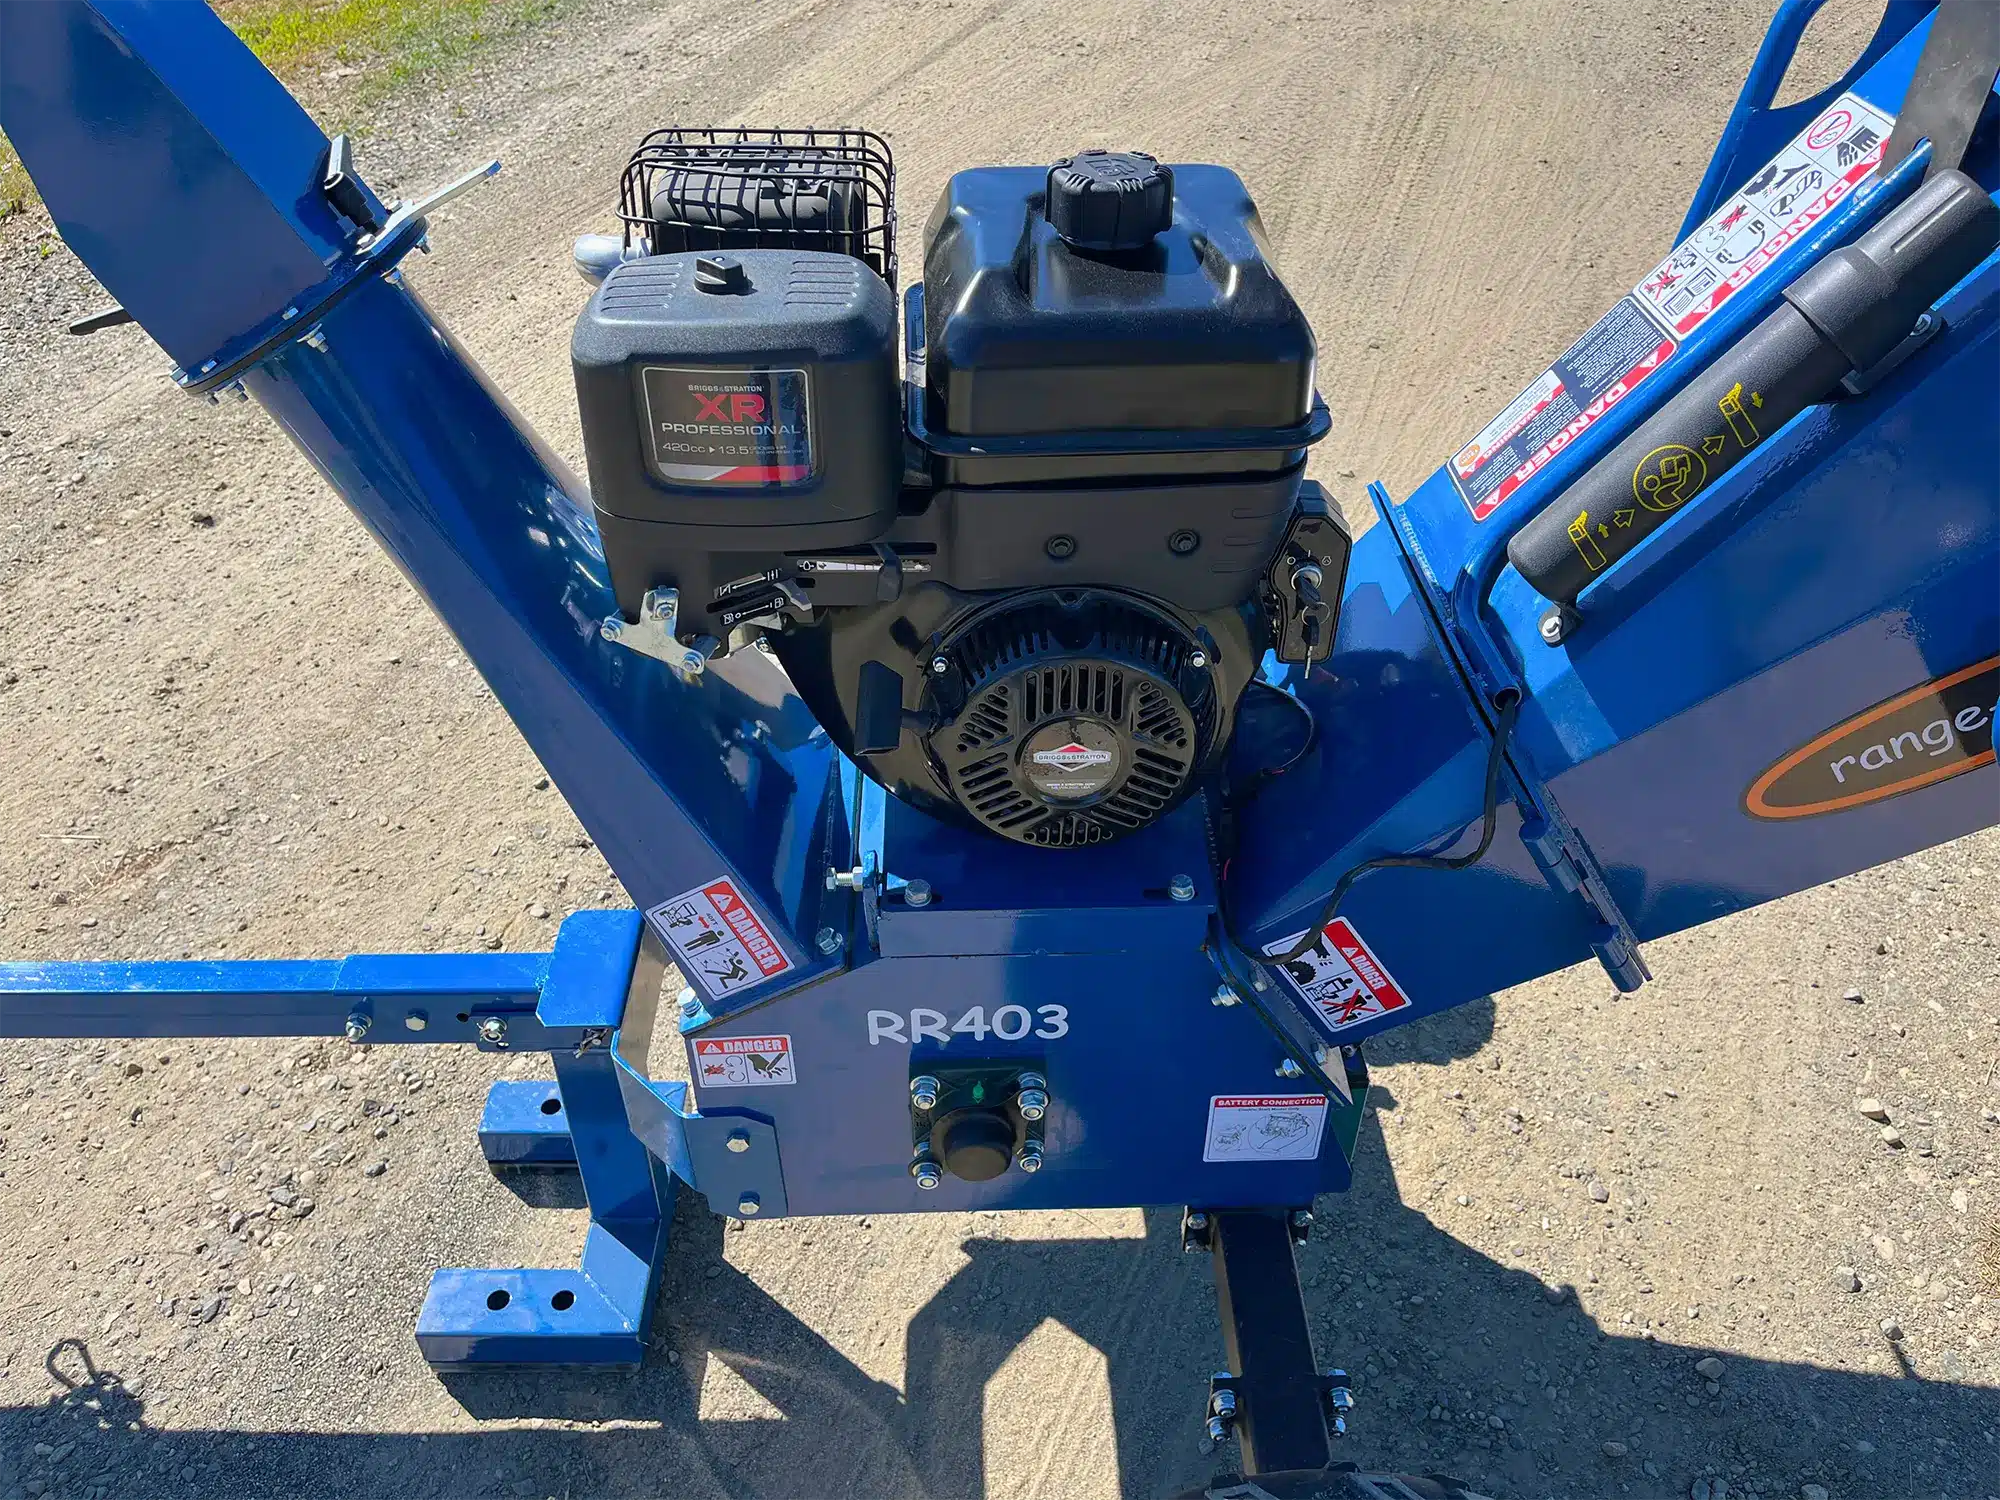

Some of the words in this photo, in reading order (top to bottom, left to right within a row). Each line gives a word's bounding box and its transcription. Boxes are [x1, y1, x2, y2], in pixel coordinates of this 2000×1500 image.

[1728, 179, 1850, 288] DANGER
[692, 393, 765, 422] XR
[661, 422, 802, 436] PROFESSIONAL
[662, 442, 706, 453] 420cc
[718, 445, 749, 455] 13.5
[1482, 409, 1539, 460] WARNING
[1515, 382, 1629, 482] DANGER
[1829, 706, 1994, 784] range
[725, 907, 781, 969] DANGER
[1350, 954, 1388, 990] DANGER
[866, 1004, 1069, 1046] RR403
[722, 1039, 783, 1053] DANGER
[1261, 1098, 1323, 1106] CONNECTION
